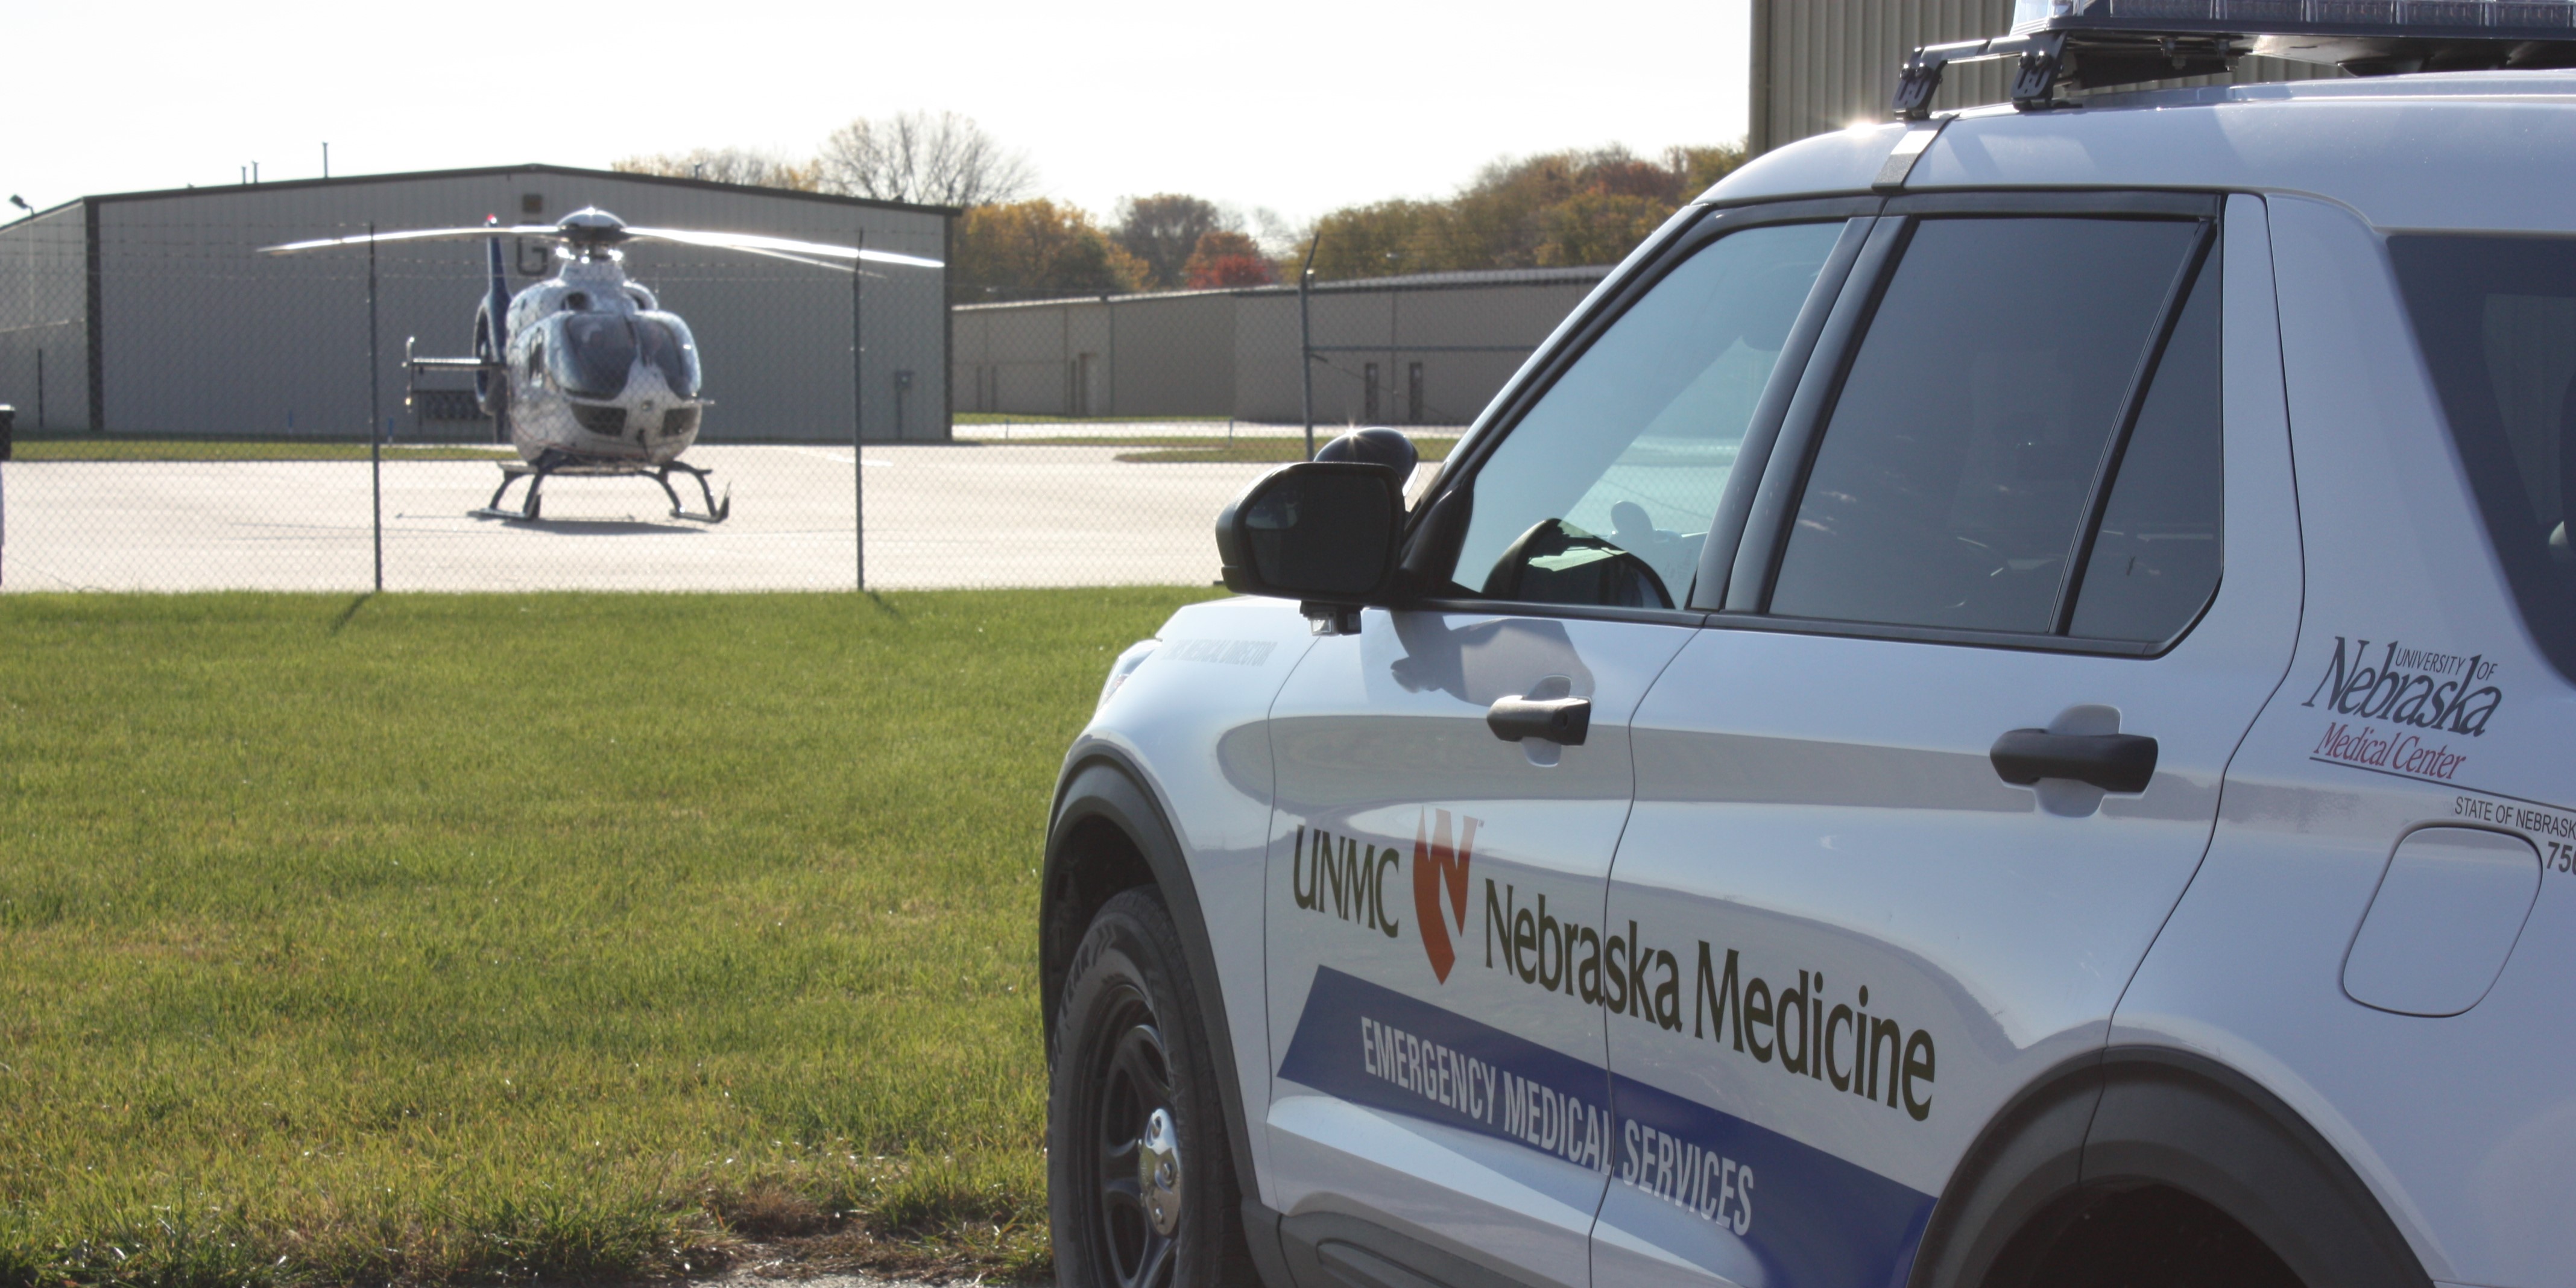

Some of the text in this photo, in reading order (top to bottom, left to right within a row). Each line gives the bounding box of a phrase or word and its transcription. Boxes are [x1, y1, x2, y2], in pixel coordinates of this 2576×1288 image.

[2302, 636, 2502, 737] Nebraska
[2396, 648, 2498, 681] UNIVERSITY OF
[2313, 722, 2466, 779] Medical Center
[2455, 796, 2493, 821] STATE
[2495, 804, 2514, 824] OF
[1293, 825, 1936, 1122] UNMC Nebraska Medicine
[1360, 1017, 1754, 1237] EMERGENCY MEDICAL SERVICES
